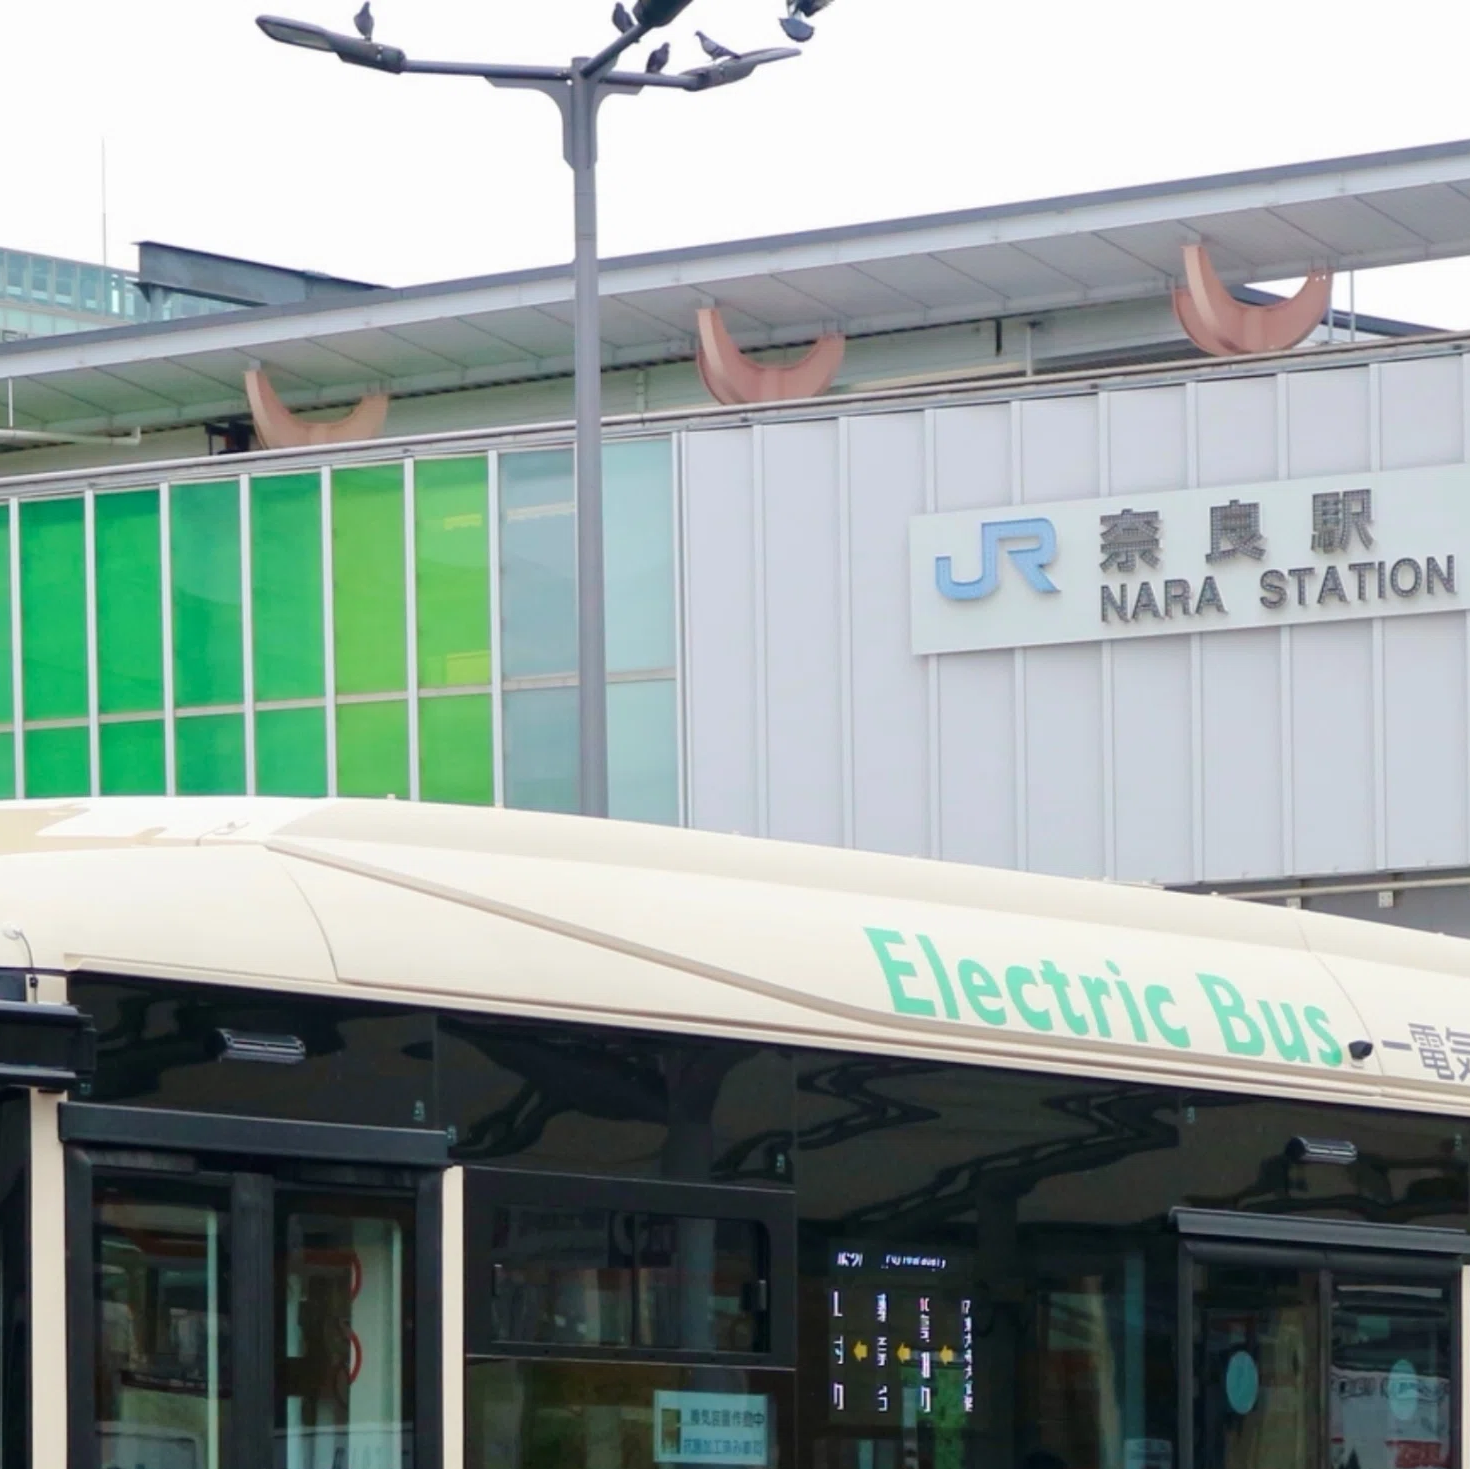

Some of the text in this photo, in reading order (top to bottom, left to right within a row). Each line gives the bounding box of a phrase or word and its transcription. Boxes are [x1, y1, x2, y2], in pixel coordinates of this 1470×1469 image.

[935, 516, 1061, 601] JR
[1099, 487, 1376, 573] 奈良駅
[1100, 553, 1458, 624] NARA STATION
[863, 926, 1344, 1067] Electric Bus
